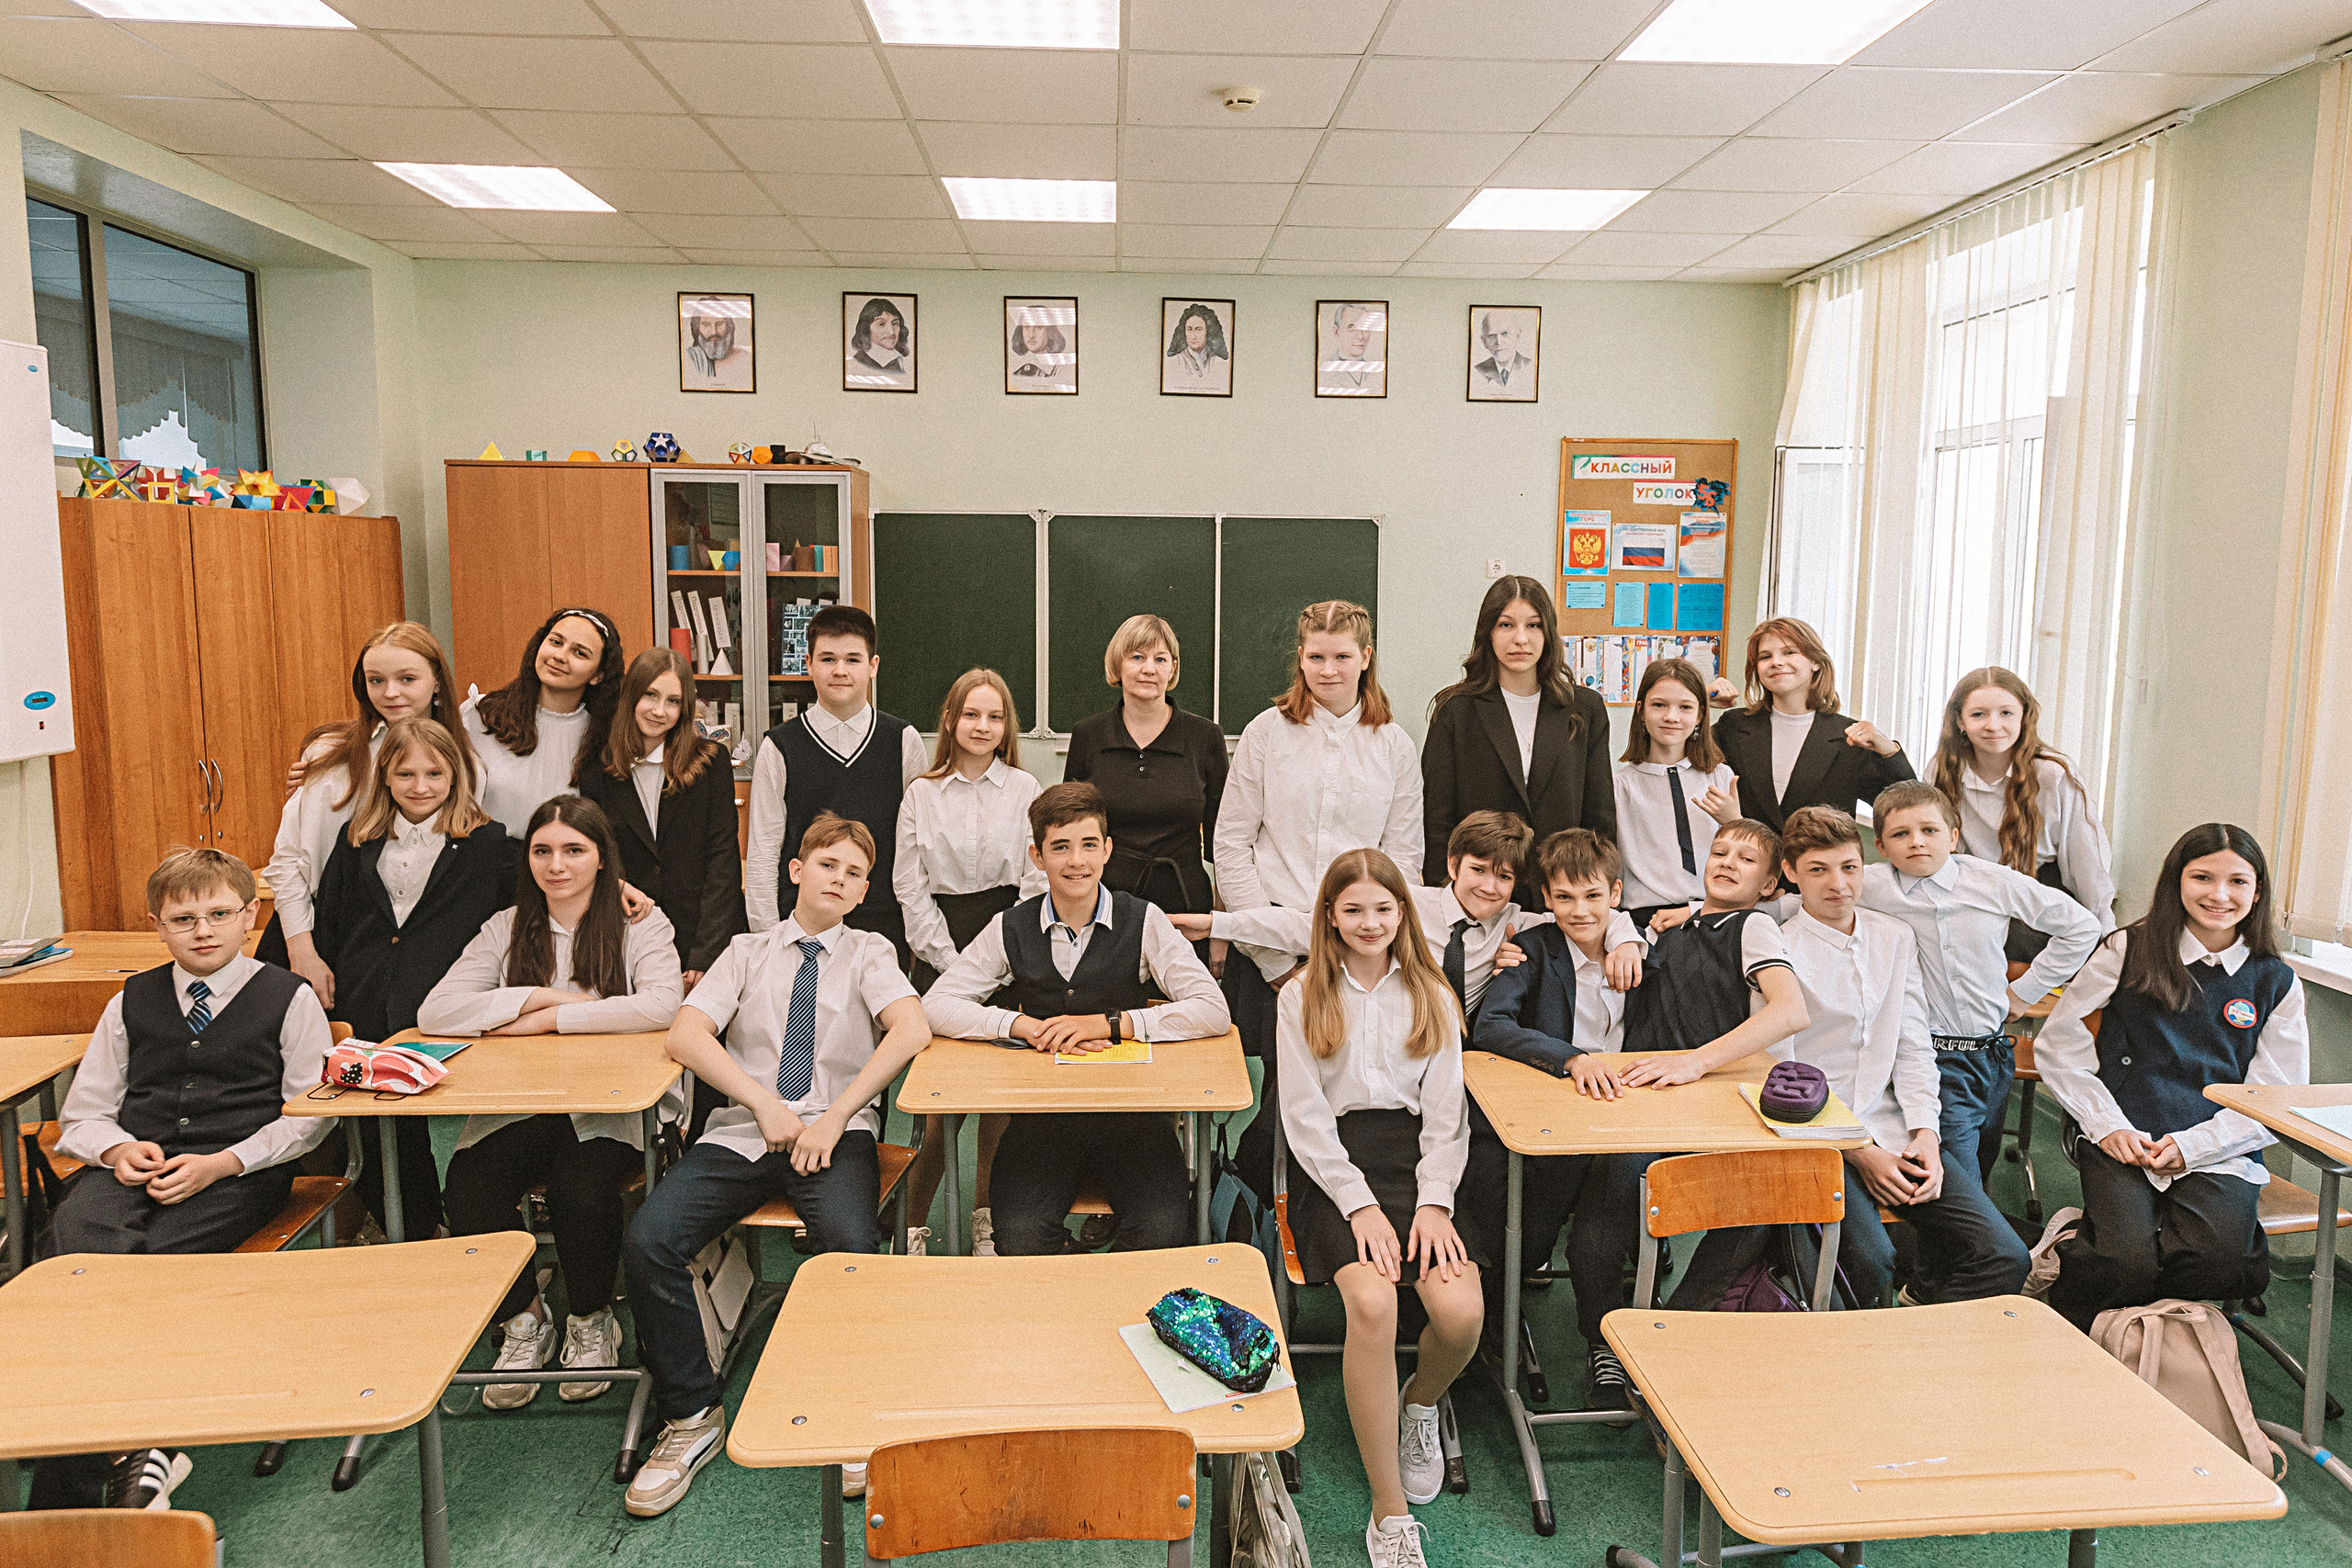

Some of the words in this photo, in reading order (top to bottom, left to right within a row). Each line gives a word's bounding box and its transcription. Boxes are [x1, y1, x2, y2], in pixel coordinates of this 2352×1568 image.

[1590, 460, 1672, 474] КЛАССНЫЙ
[1635, 487, 1693, 500] УГОЛОК
[1932, 1037, 1978, 1051] RFUL
